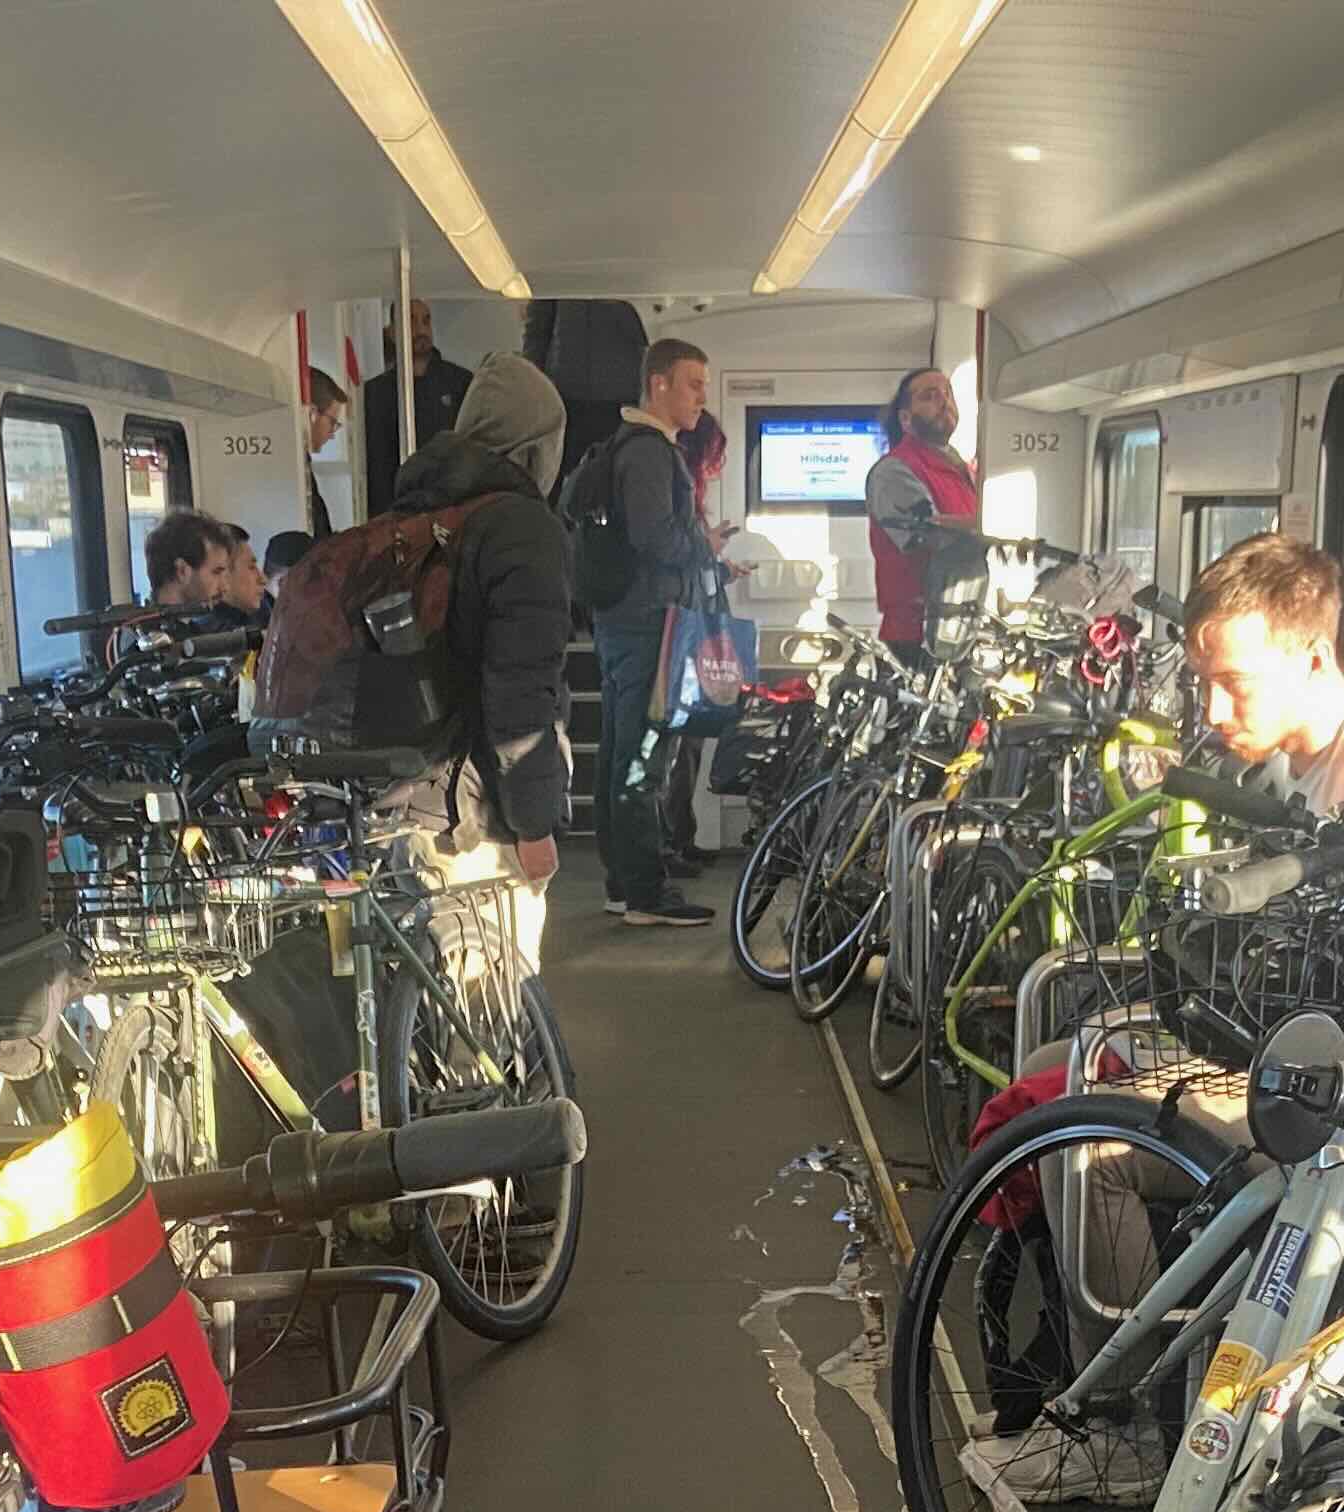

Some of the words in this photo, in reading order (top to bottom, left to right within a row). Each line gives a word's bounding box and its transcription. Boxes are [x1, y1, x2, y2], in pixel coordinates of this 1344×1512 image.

[223, 436, 272, 455] 3052
[1010, 432, 1060, 453] 3052
[800, 454, 850, 465] Hillsdale
[1272, 1227, 1304, 1283] BERKELEY
[1261, 1282, 1279, 1308] LAB
